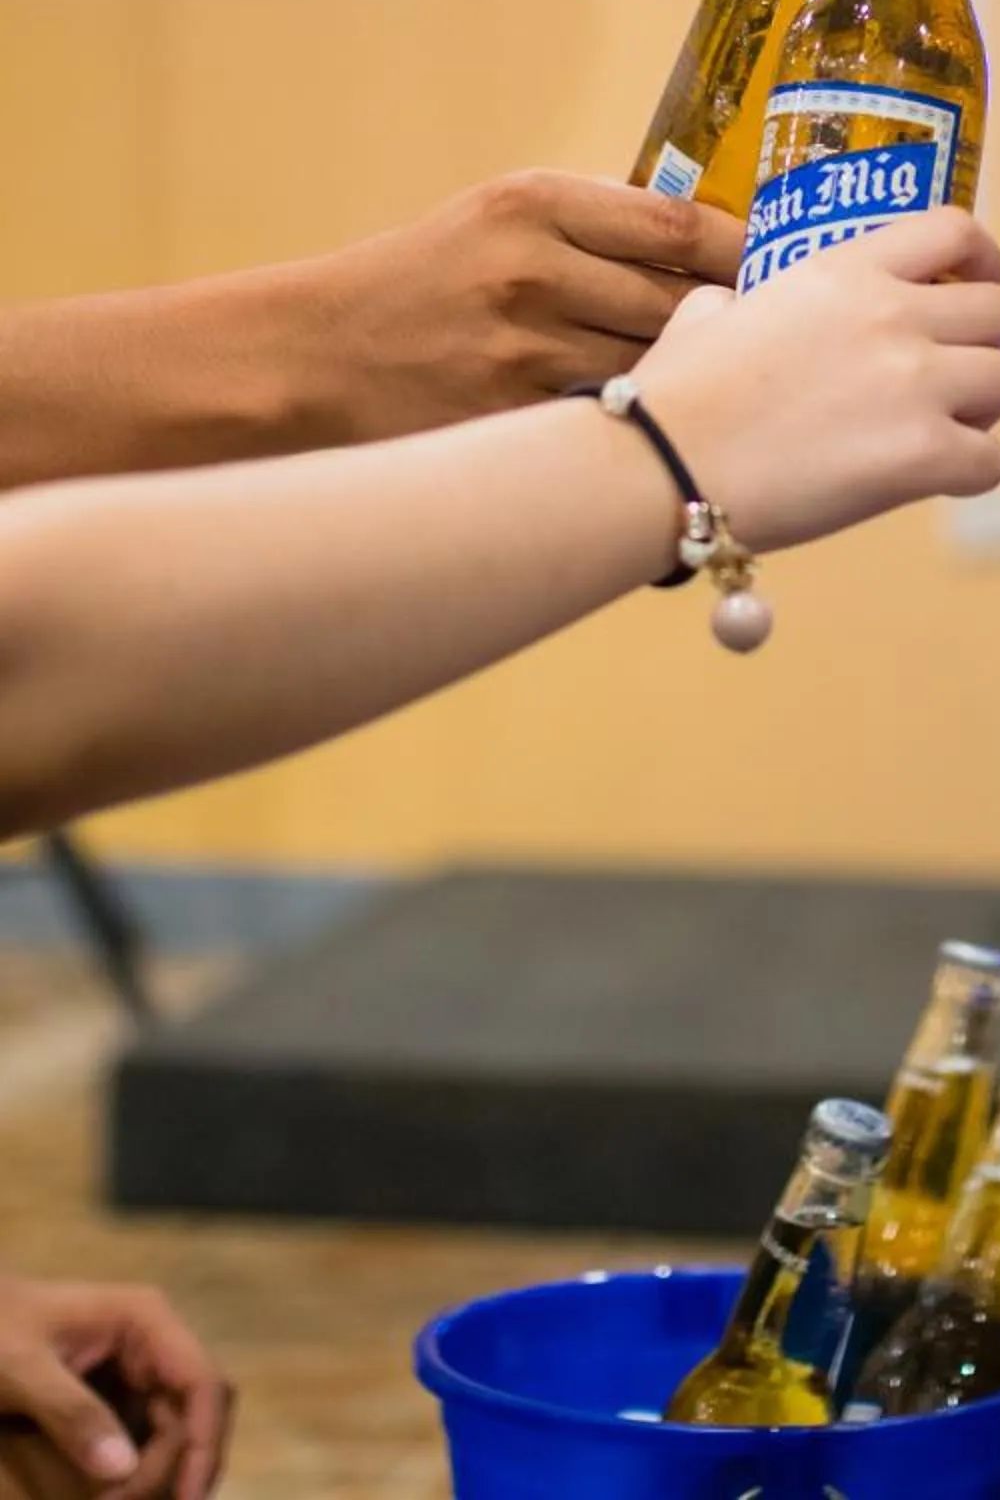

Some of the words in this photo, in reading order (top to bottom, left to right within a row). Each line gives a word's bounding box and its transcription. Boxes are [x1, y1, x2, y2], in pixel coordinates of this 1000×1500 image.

[746, 184, 804, 248] San
[807, 151, 919, 220] Mig
[741, 220, 894, 296] LIGH
